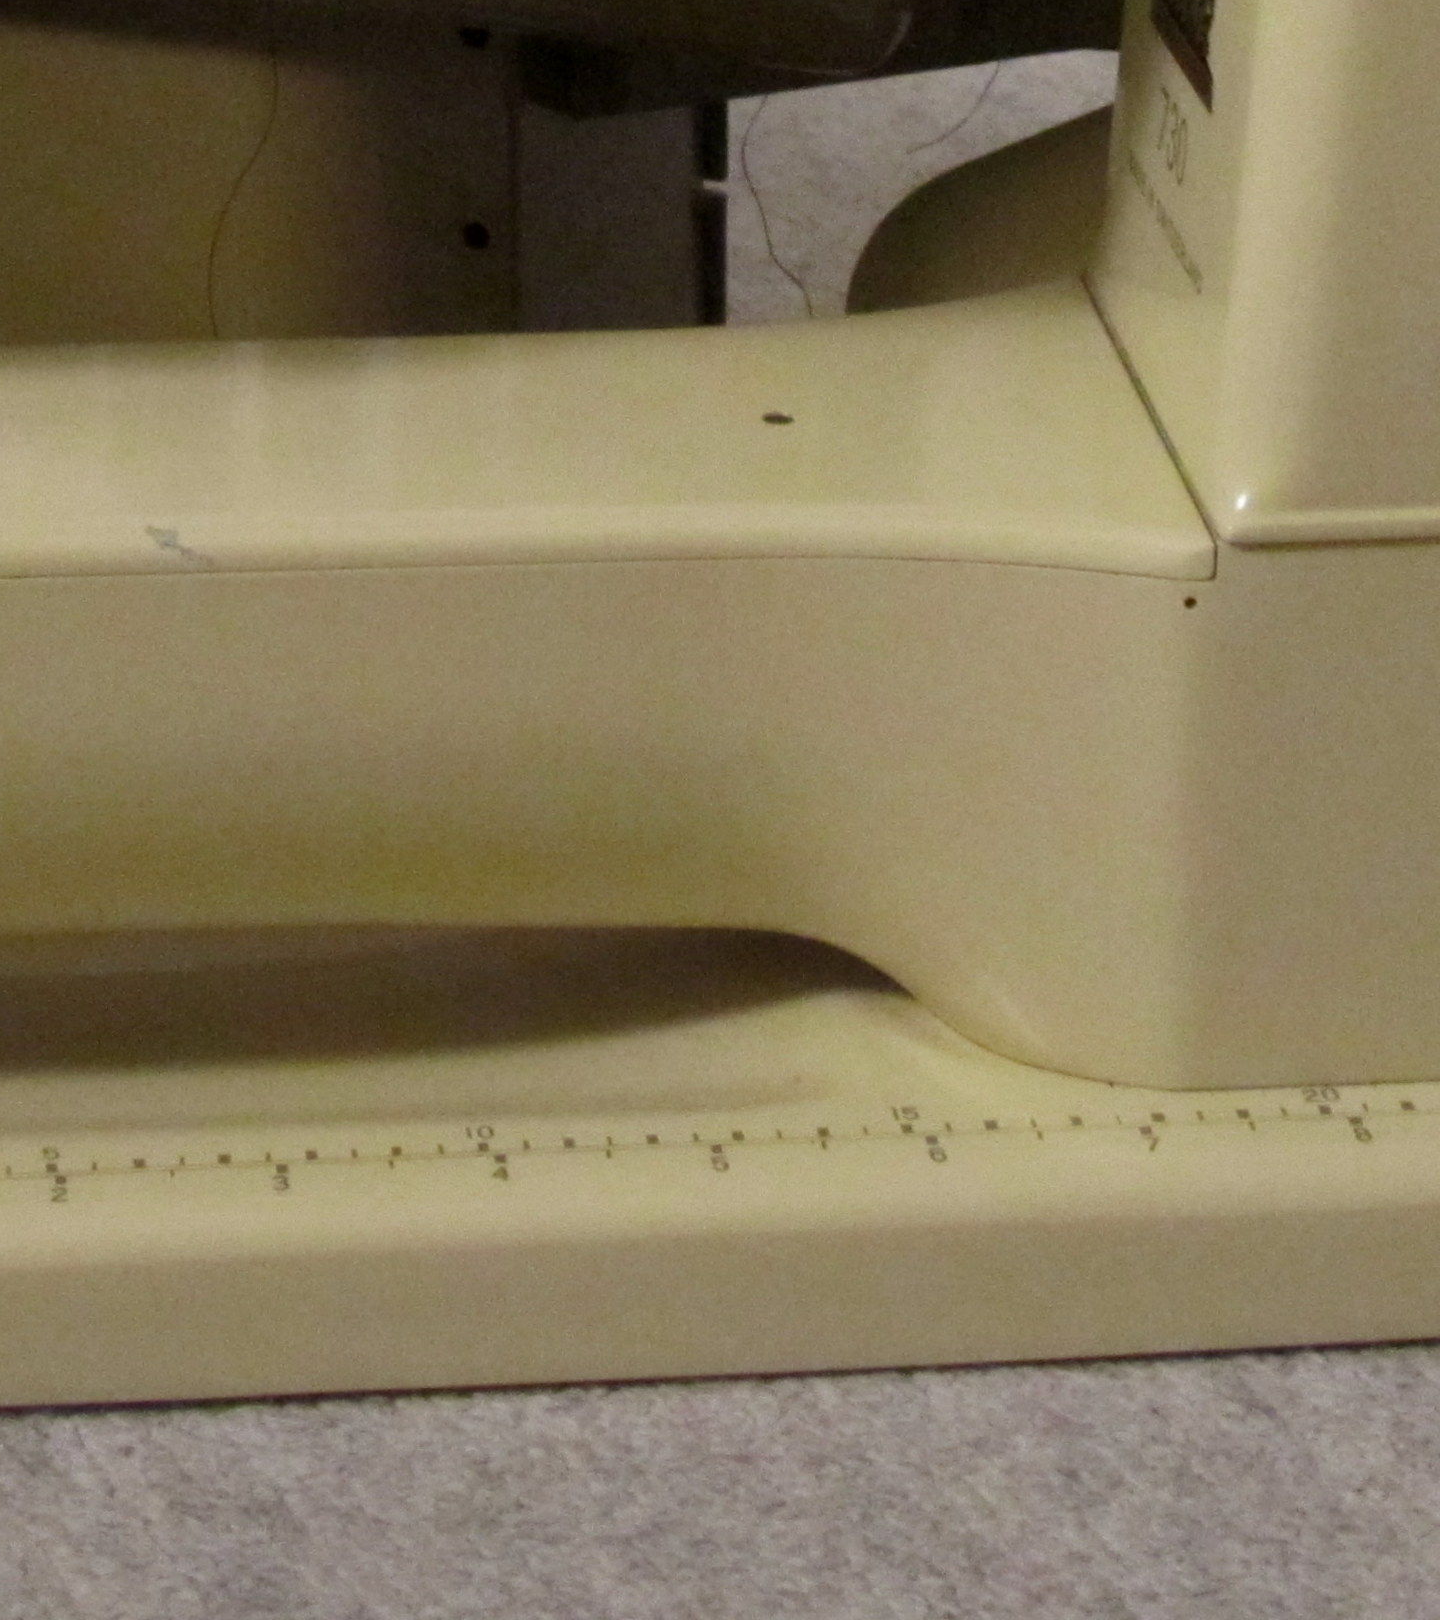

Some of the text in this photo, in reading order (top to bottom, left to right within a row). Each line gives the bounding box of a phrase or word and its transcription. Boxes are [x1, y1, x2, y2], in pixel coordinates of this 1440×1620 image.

[465, 1124, 496, 1140] 10
[891, 1106, 920, 1121] 15
[1301, 1085, 1341, 1103] 20
[50, 1186, 68, 1202] 2
[271, 1173, 291, 1191] 3
[1145, 1136, 1160, 1152] 7
